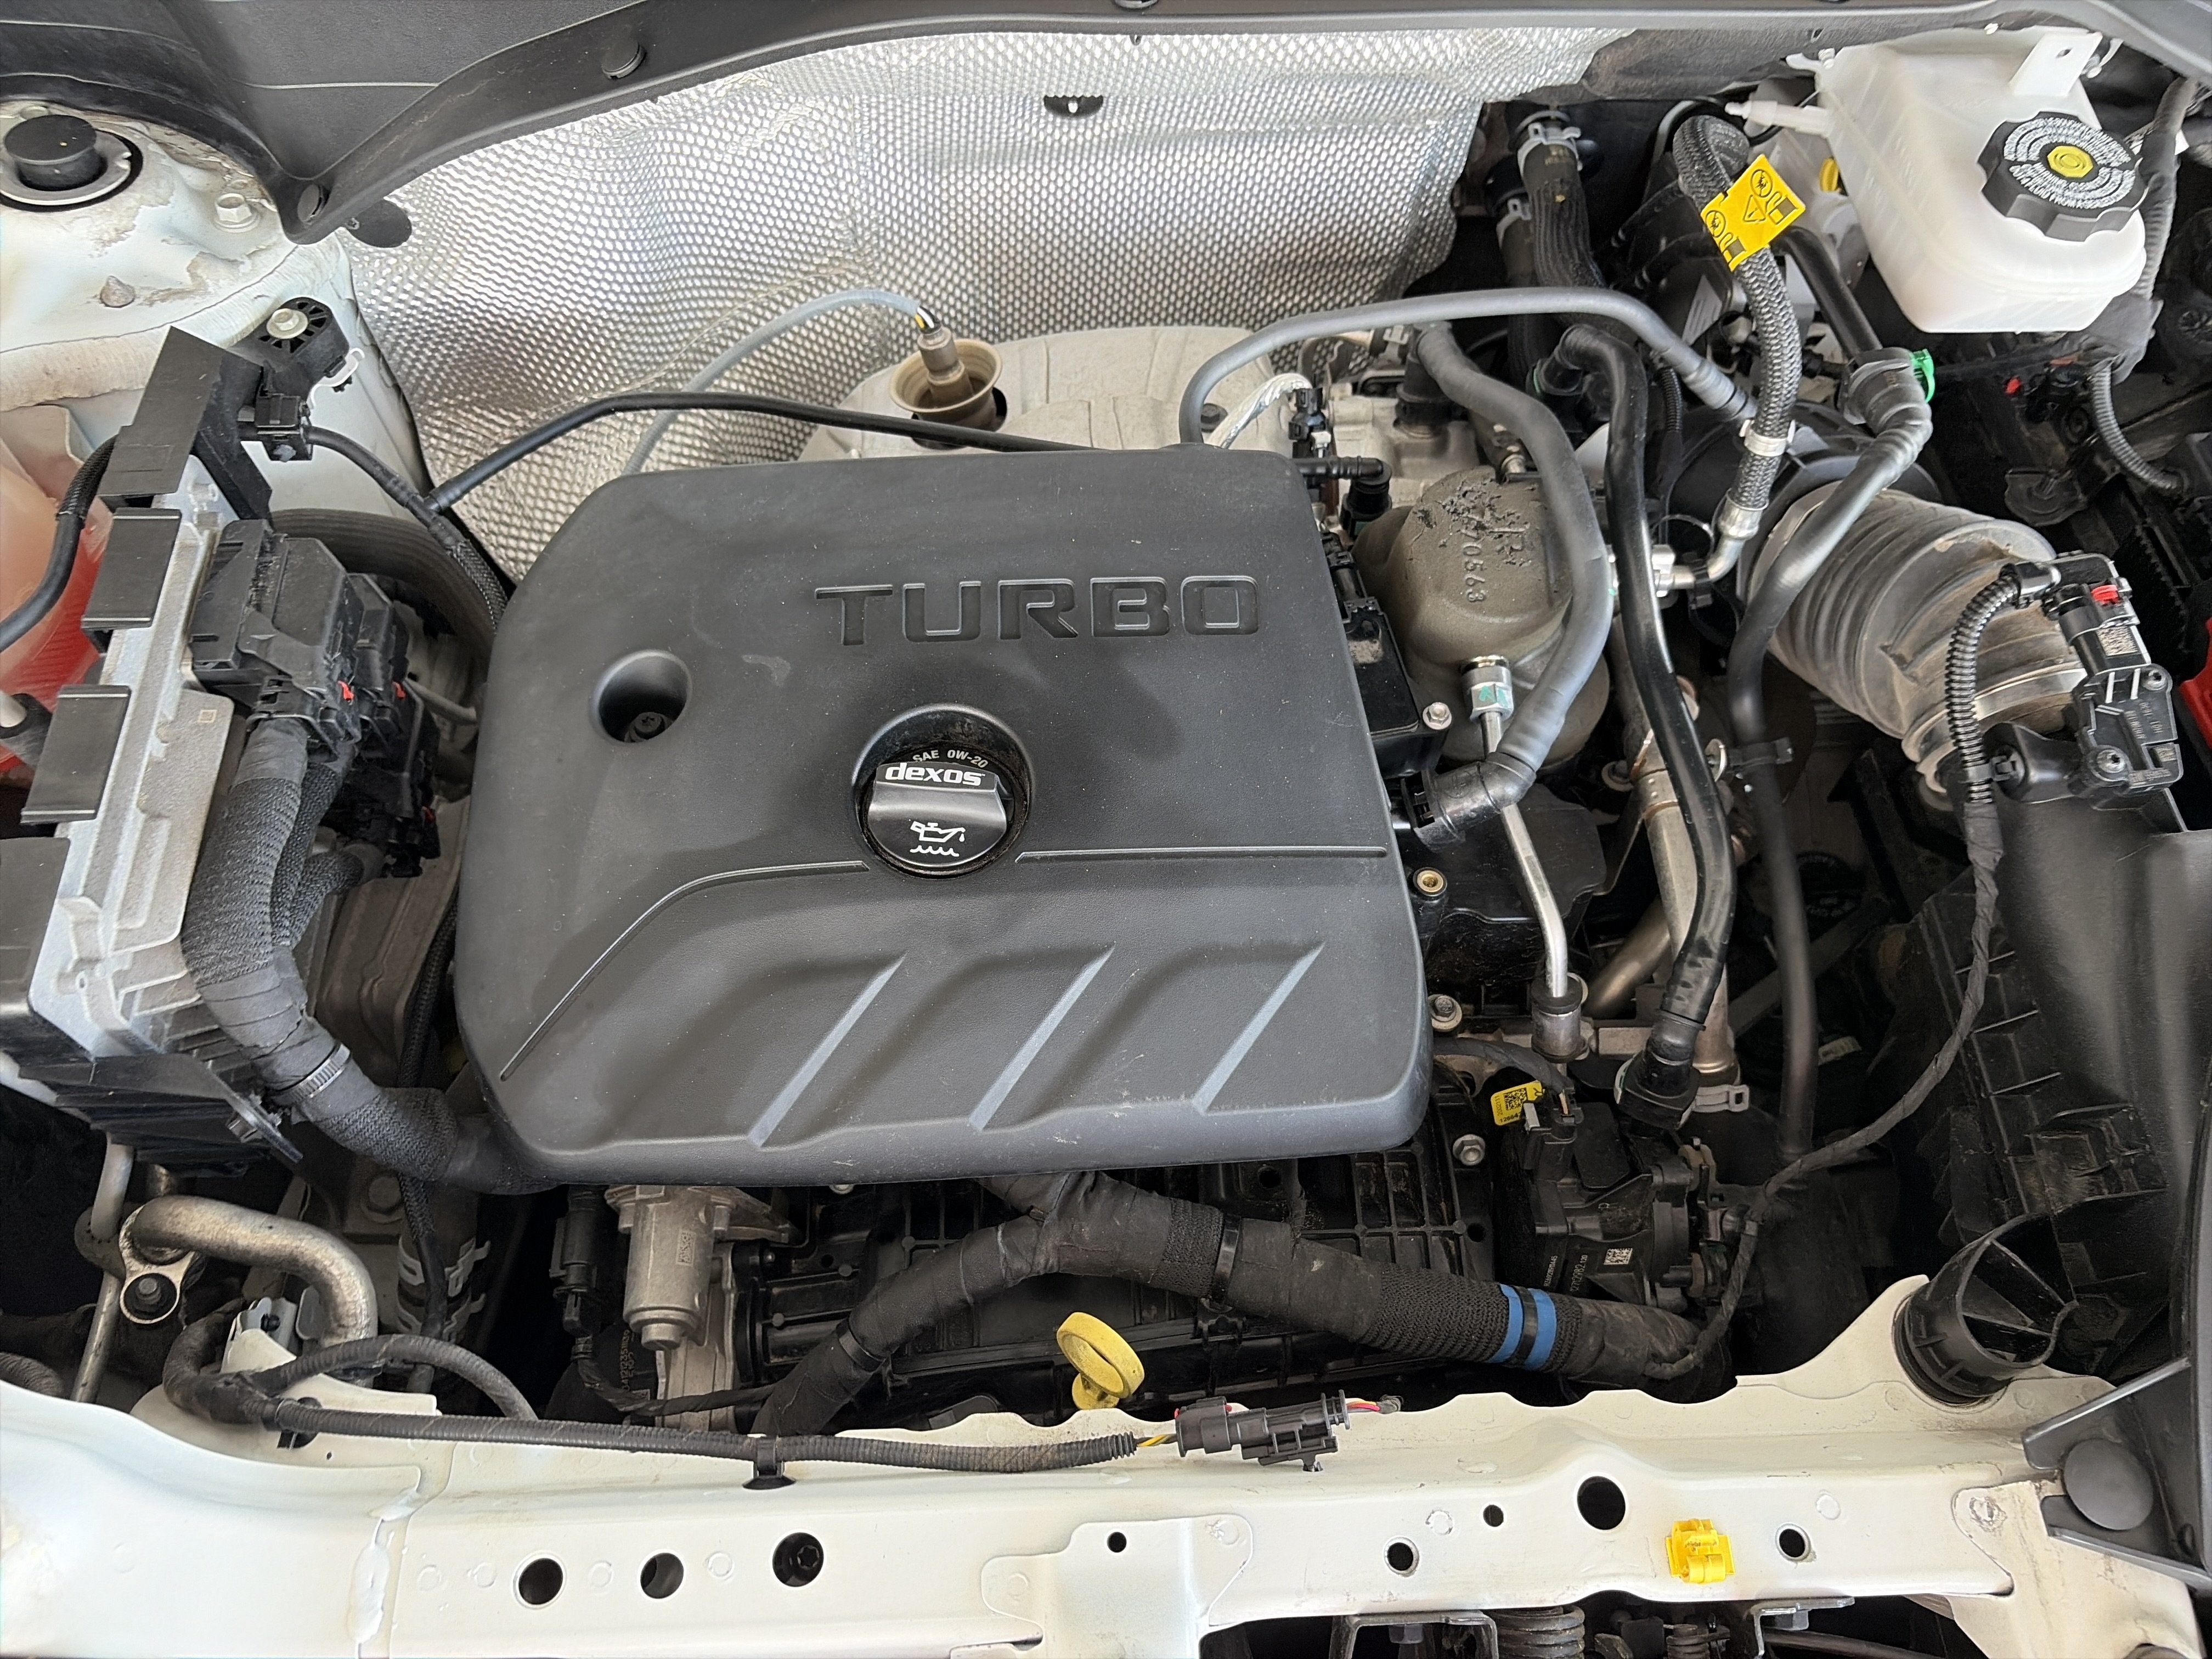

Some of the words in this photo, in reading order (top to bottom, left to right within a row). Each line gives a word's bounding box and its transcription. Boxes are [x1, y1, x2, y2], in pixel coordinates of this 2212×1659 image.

[814, 576, 1259, 646] TURBO
[913, 750, 940, 762] SAE
[947, 749, 989, 768] 0W-20
[885, 763, 982, 786] dexos
